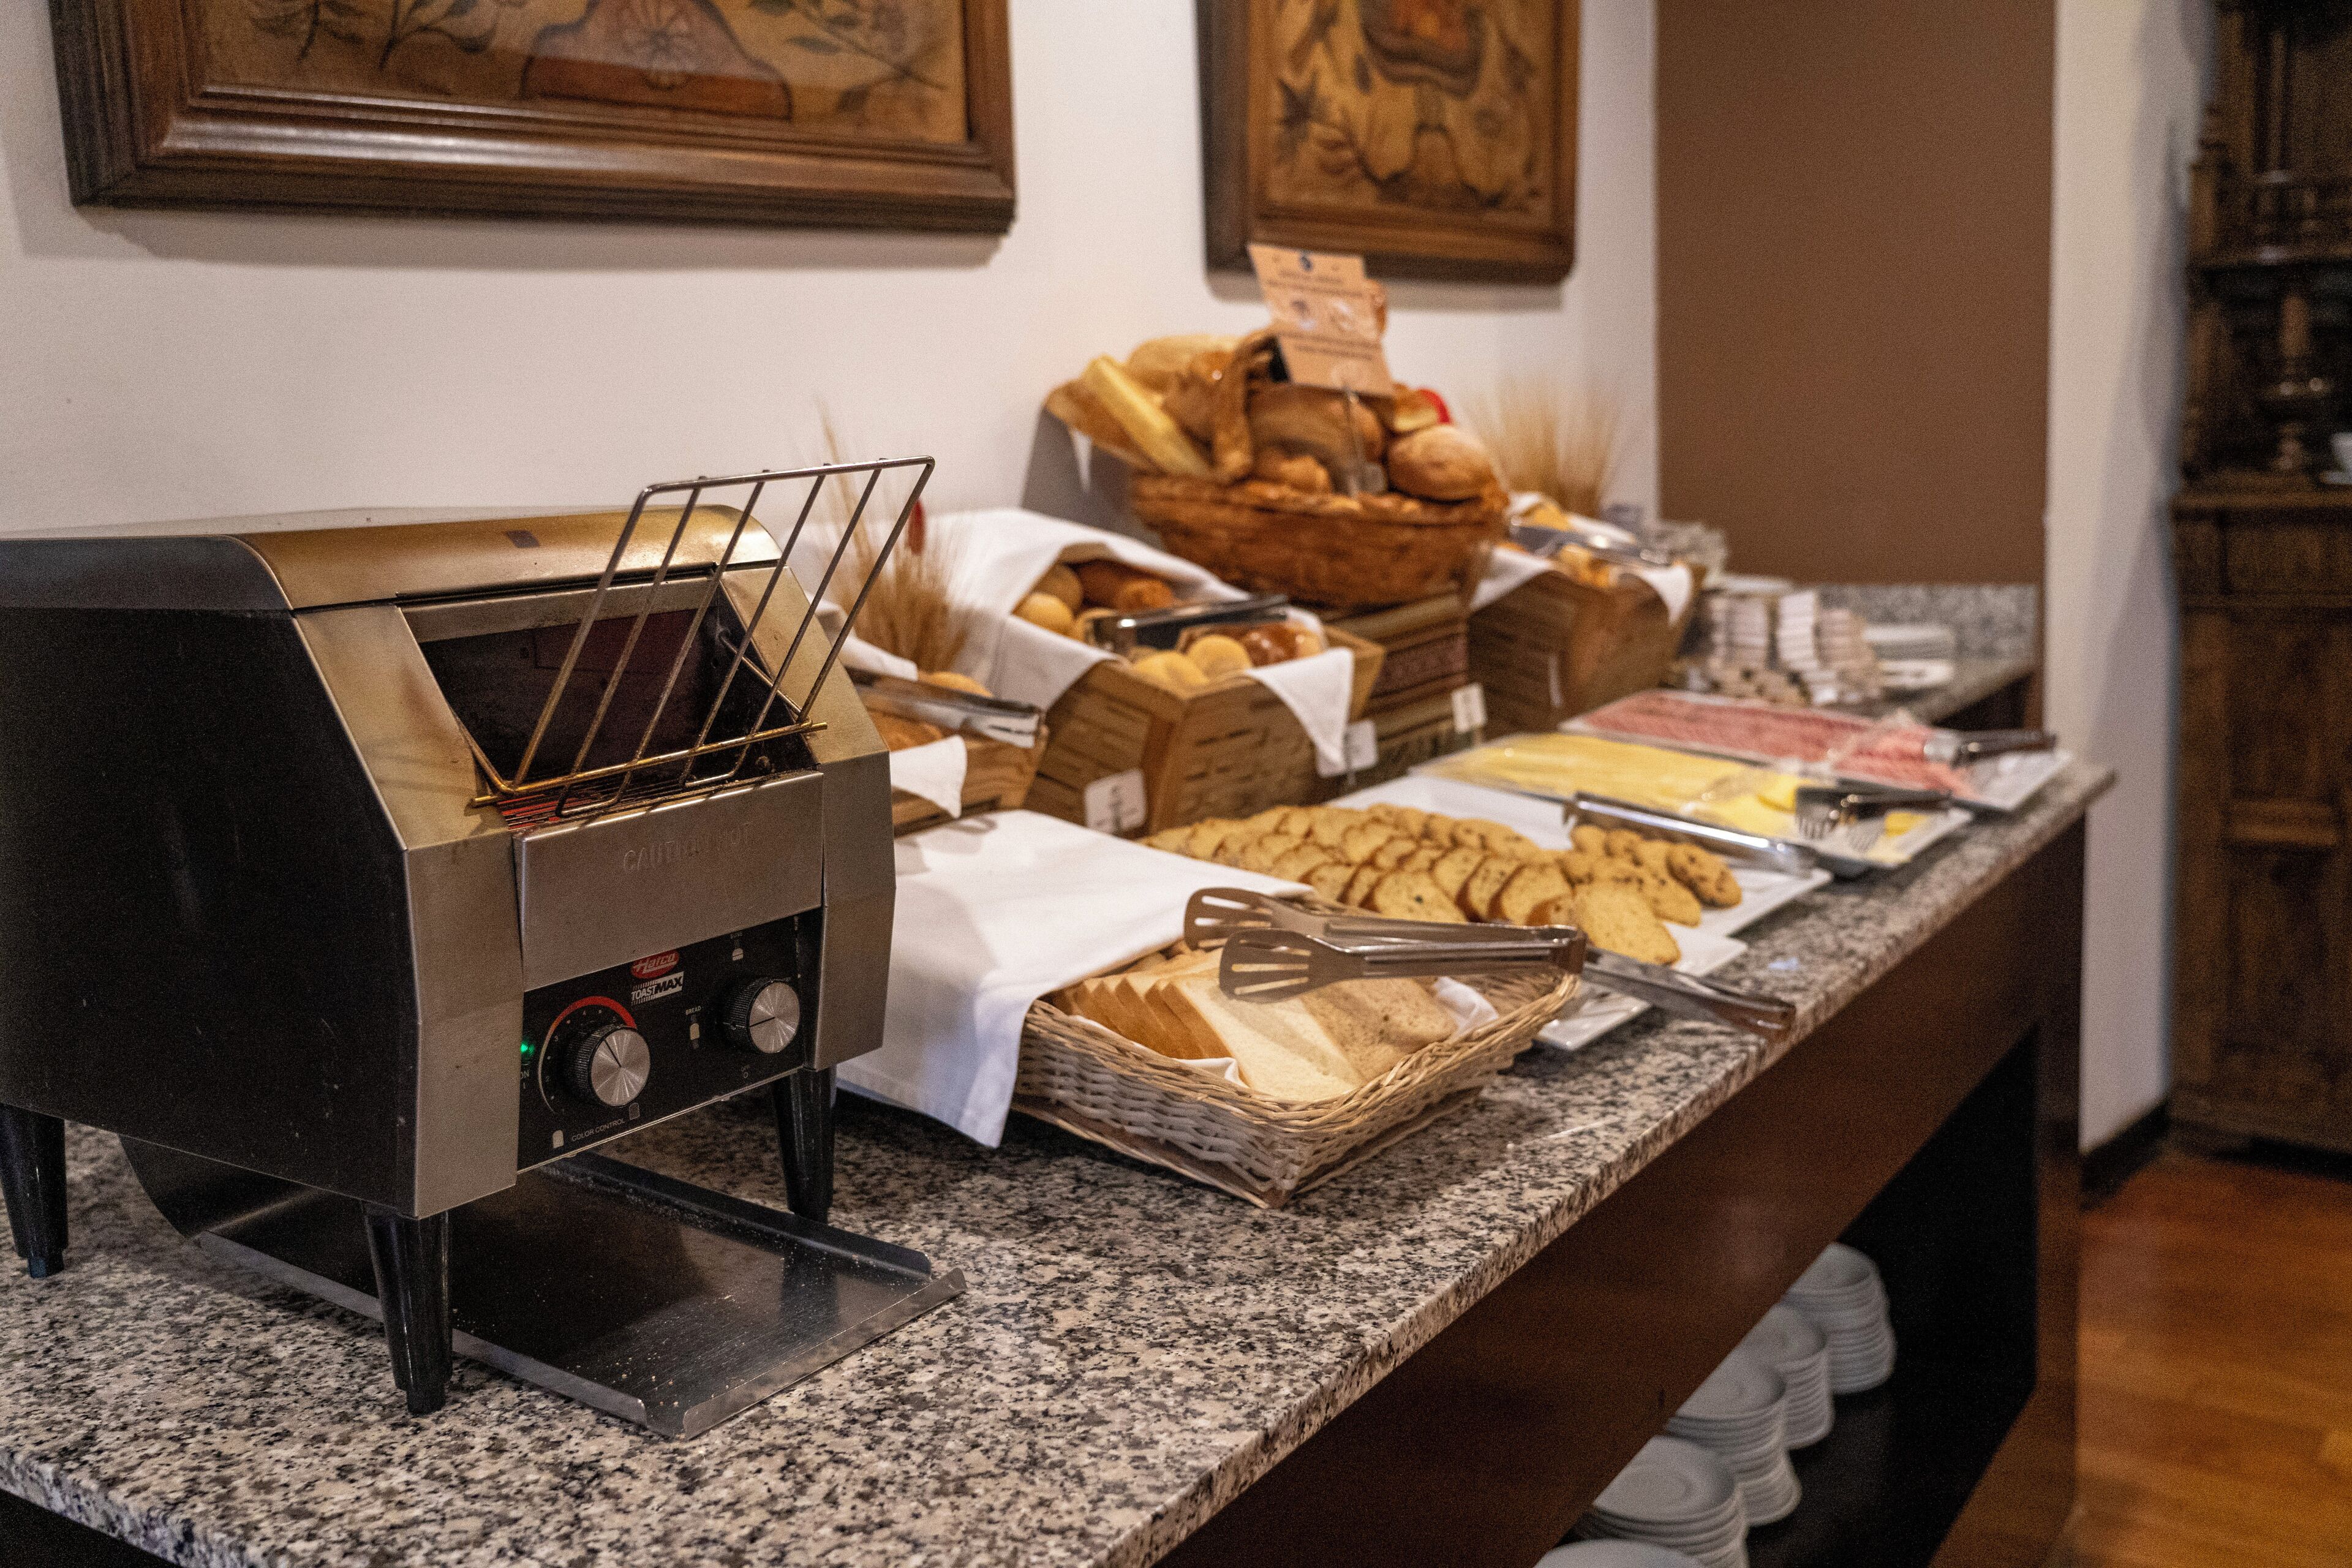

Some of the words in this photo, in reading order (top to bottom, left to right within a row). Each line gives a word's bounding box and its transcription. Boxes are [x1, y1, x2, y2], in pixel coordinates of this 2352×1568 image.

[633, 952, 676, 974] Hatco
[631, 976, 682, 1001] TOASTMAX
[685, 1005, 701, 1016] BREAD
[571, 1129, 594, 1142] COLOR
[595, 1118, 625, 1134] CONTROL
